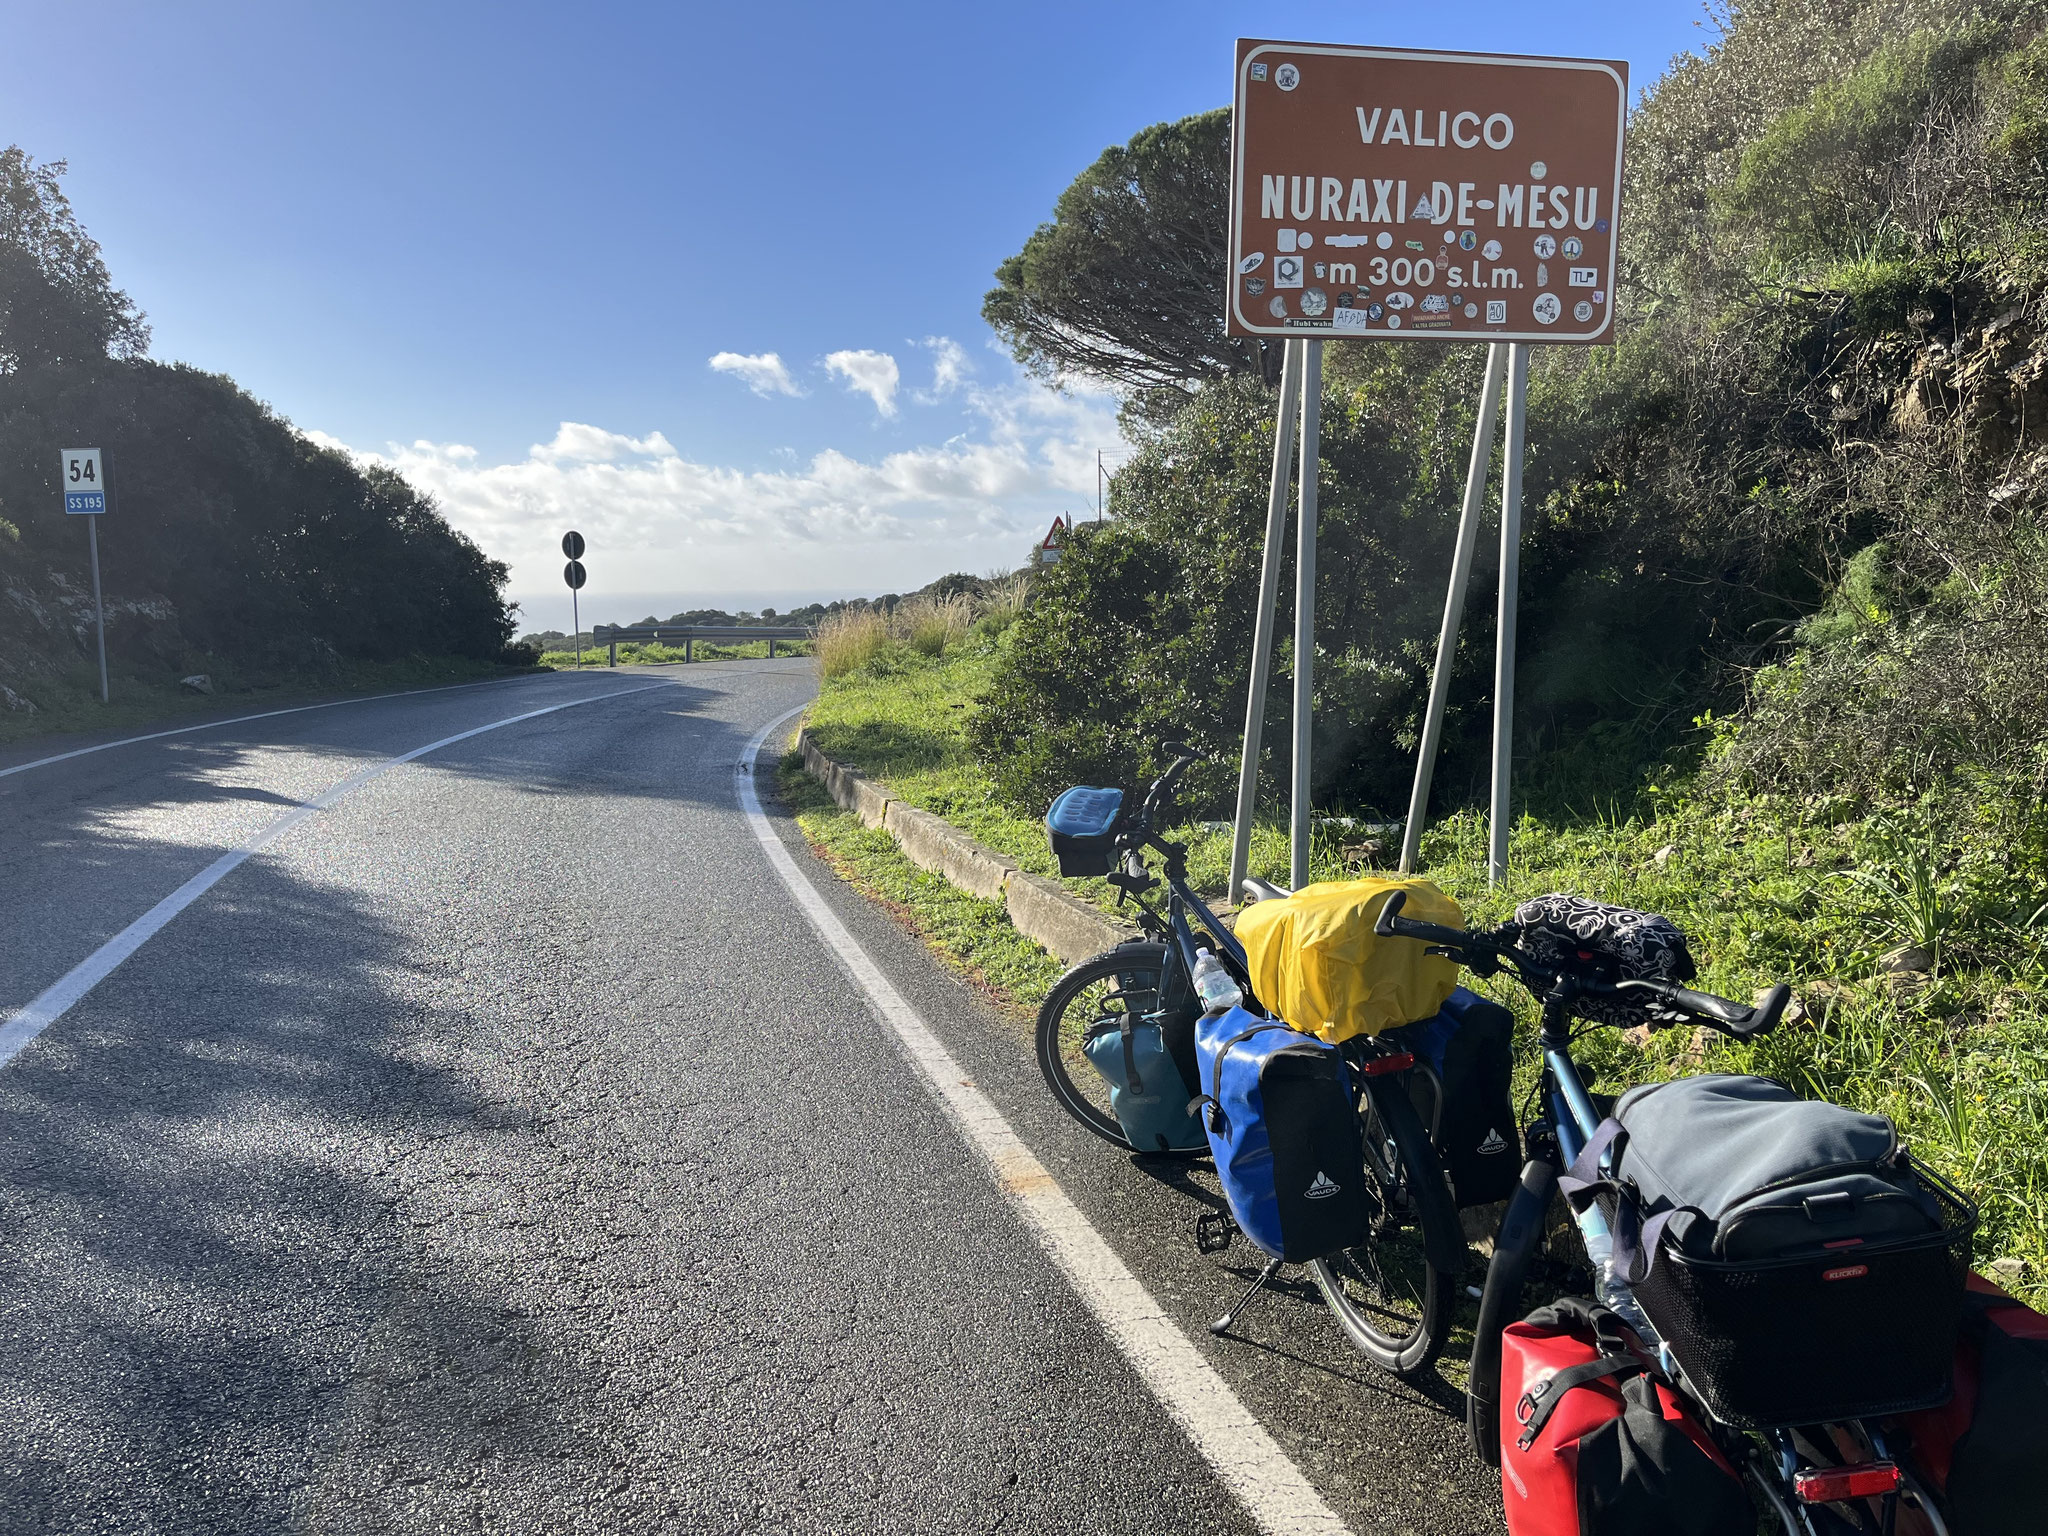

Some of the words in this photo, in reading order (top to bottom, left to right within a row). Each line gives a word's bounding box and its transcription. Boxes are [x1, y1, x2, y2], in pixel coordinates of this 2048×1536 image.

[1356, 107, 1514, 150] VALICO
[1262, 175, 1406, 224] NURAXI
[1330, 262, 1356, 284] m
[1369, 257, 1435, 287] 300
[1447, 260, 1523, 289] s.l.m.
[1572, 271, 1594, 282] TLP
[69, 459, 95, 482] 54
[70, 498, 82, 508] SS
[84, 497, 102, 508] 195
[1309, 1187, 1336, 1196] VAUDE
